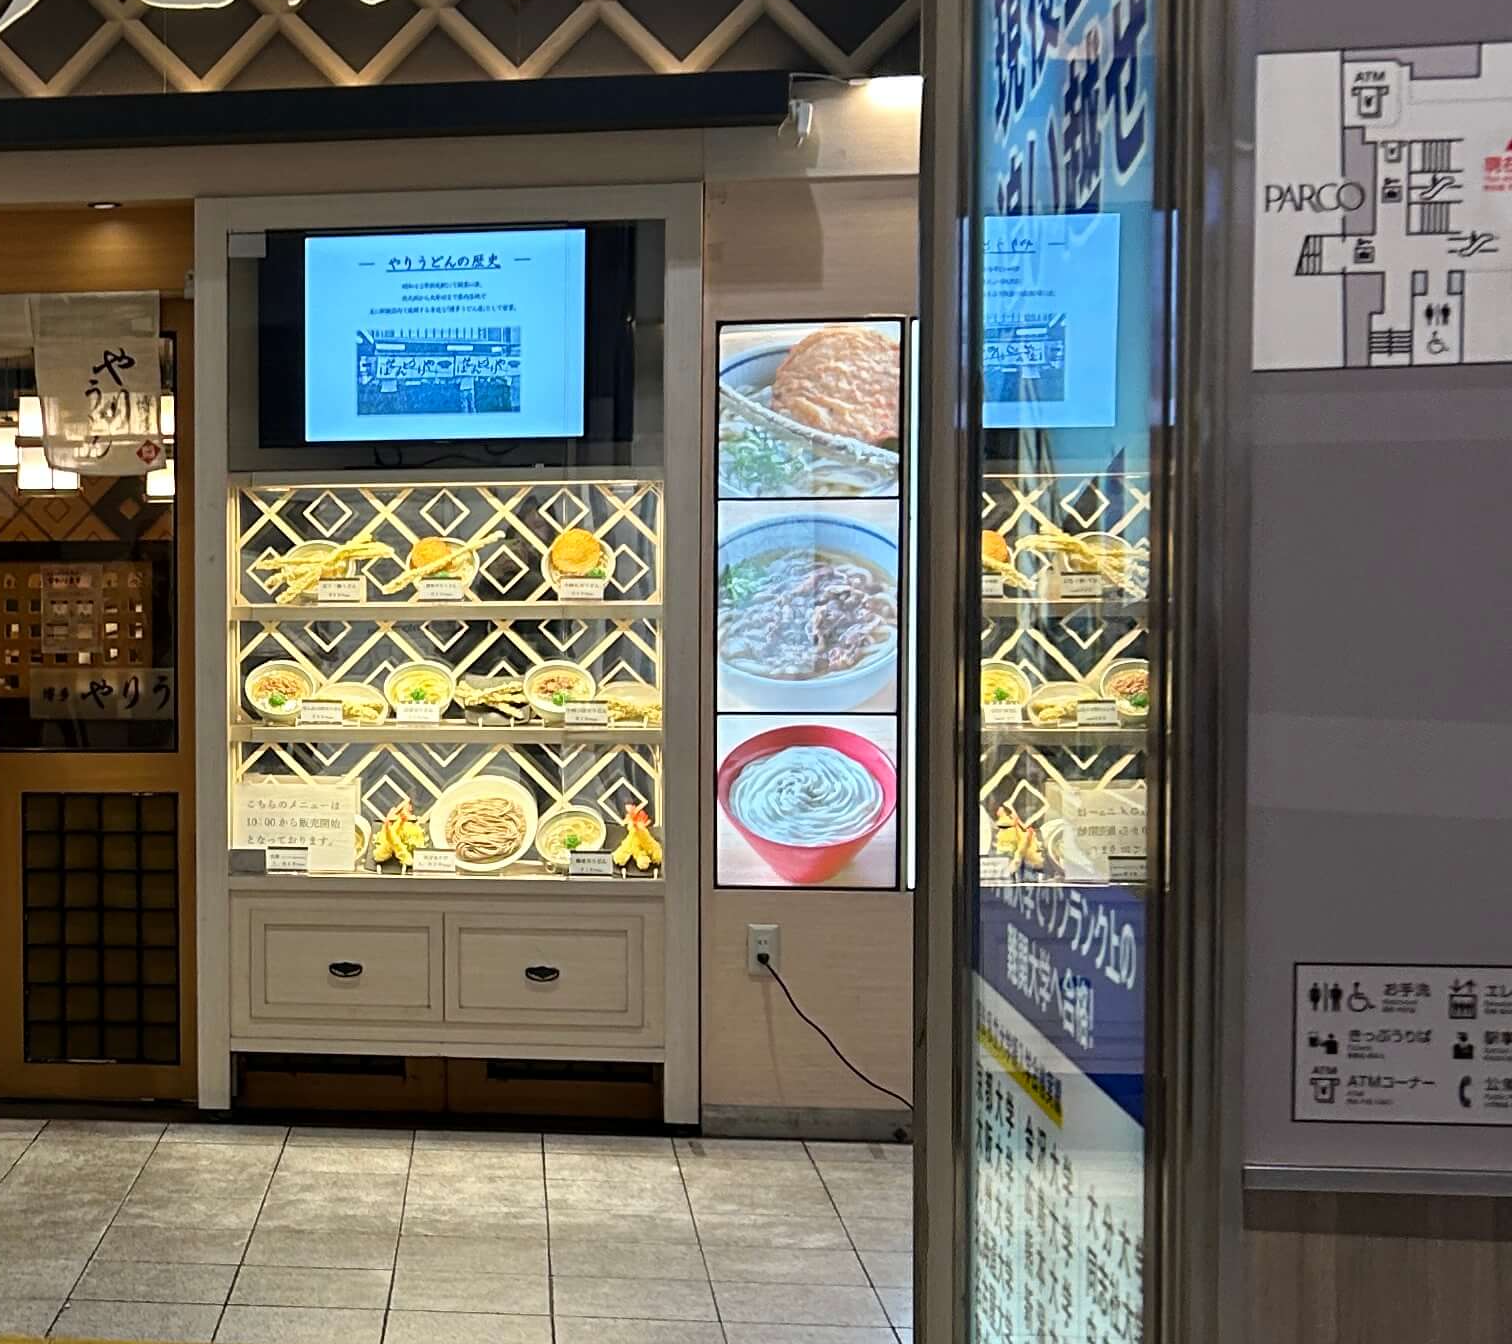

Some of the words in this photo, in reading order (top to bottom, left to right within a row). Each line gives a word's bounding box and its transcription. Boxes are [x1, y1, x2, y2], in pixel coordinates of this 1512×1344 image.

[1353, 70, 1386, 83] ATM
[1264, 181, 1367, 214] PARCO
[388, 253, 502, 272] やりうどんの歴史
[247, 799, 340, 810] こちらのメニューは
[247, 834, 333, 846] となっております。
[1348, 1029, 1432, 1044] きっぷうりば
[1346, 1075, 1436, 1089] ATMコーナー
